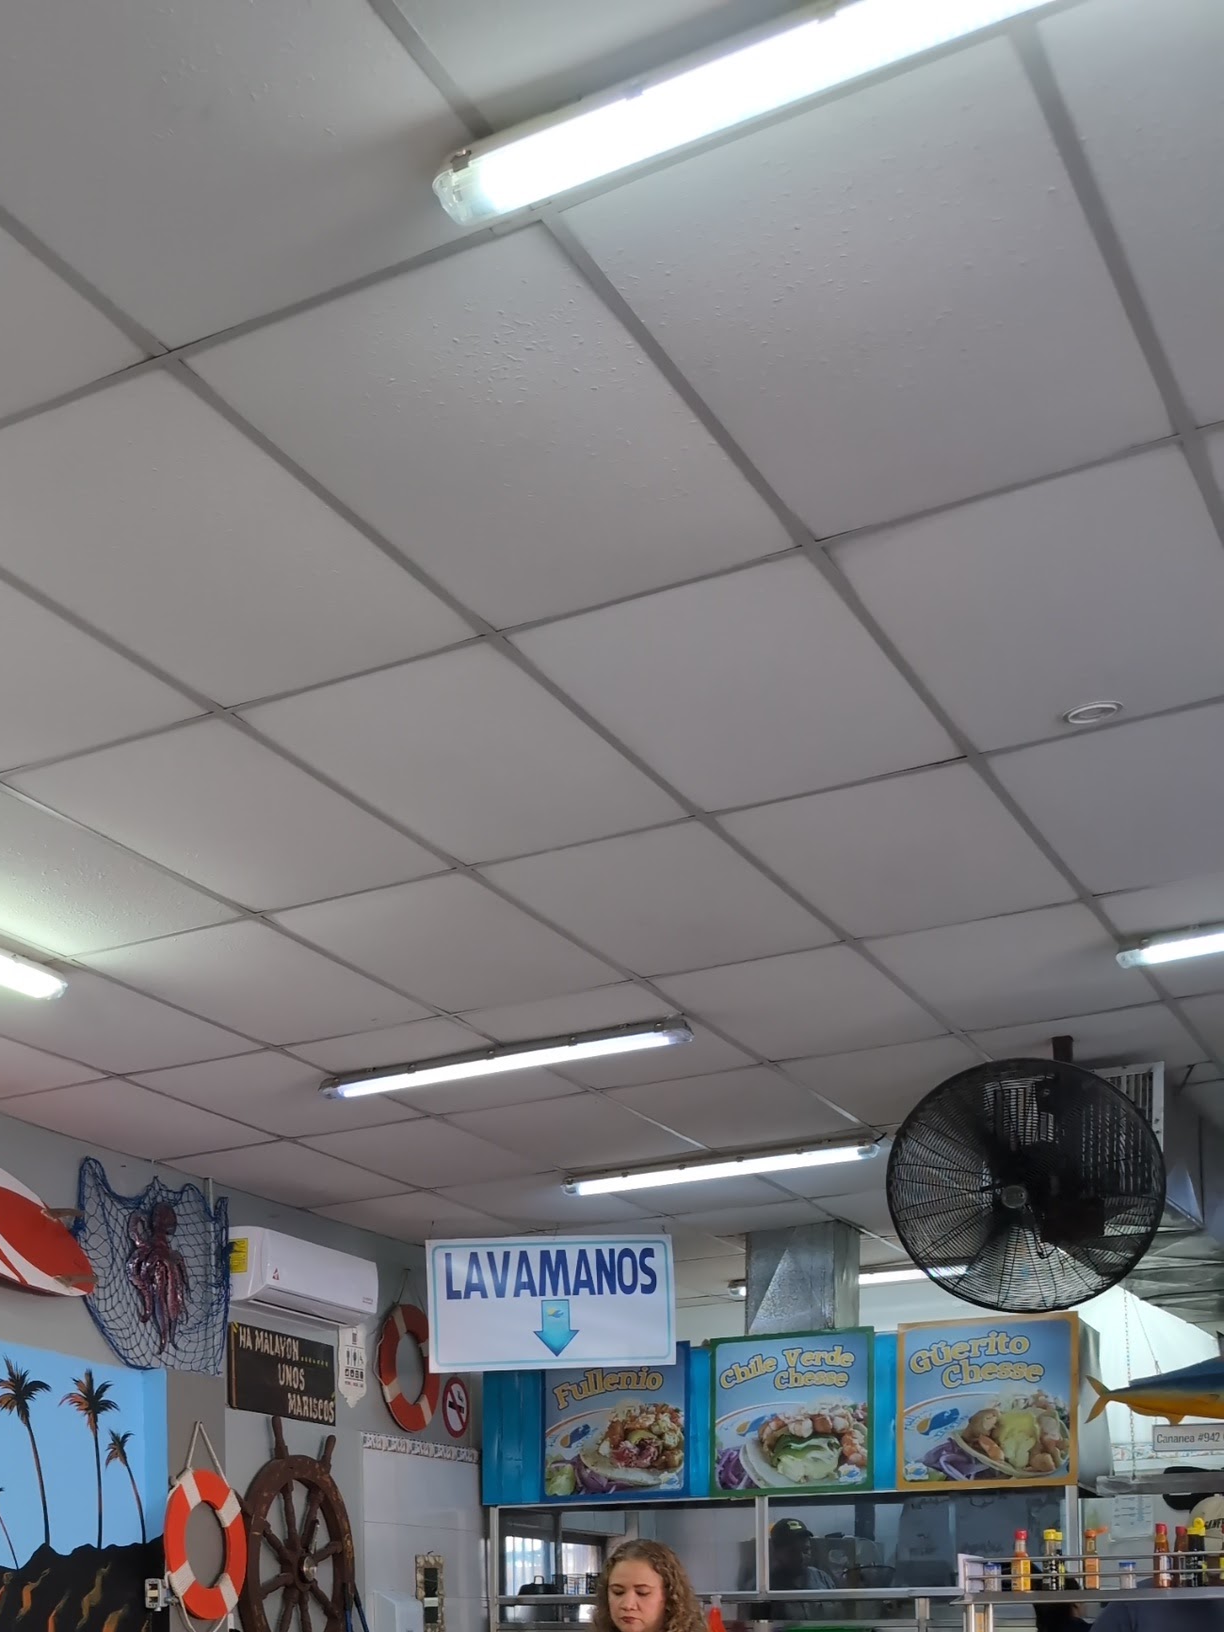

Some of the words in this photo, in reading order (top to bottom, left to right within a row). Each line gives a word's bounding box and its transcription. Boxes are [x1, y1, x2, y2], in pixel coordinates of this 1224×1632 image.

[444, 1247, 658, 1300] LAVAMANOS
[239, 1325, 253, 1351] HA
[908, 1330, 1031, 1374] Güerito
[277, 1362, 305, 1391] UNOS
[719, 1353, 778, 1389] Chile
[782, 1344, 856, 1368] Verde
[774, 1366, 850, 1390] Chesse
[941, 1358, 1046, 1389] Chesse
[552, 1366, 664, 1411] Fullenio
[287, 1392, 335, 1423] MARISCOS
[1156, 1433, 1195, 1444] Cananea
[1196, 1430, 1221, 1443] #942
